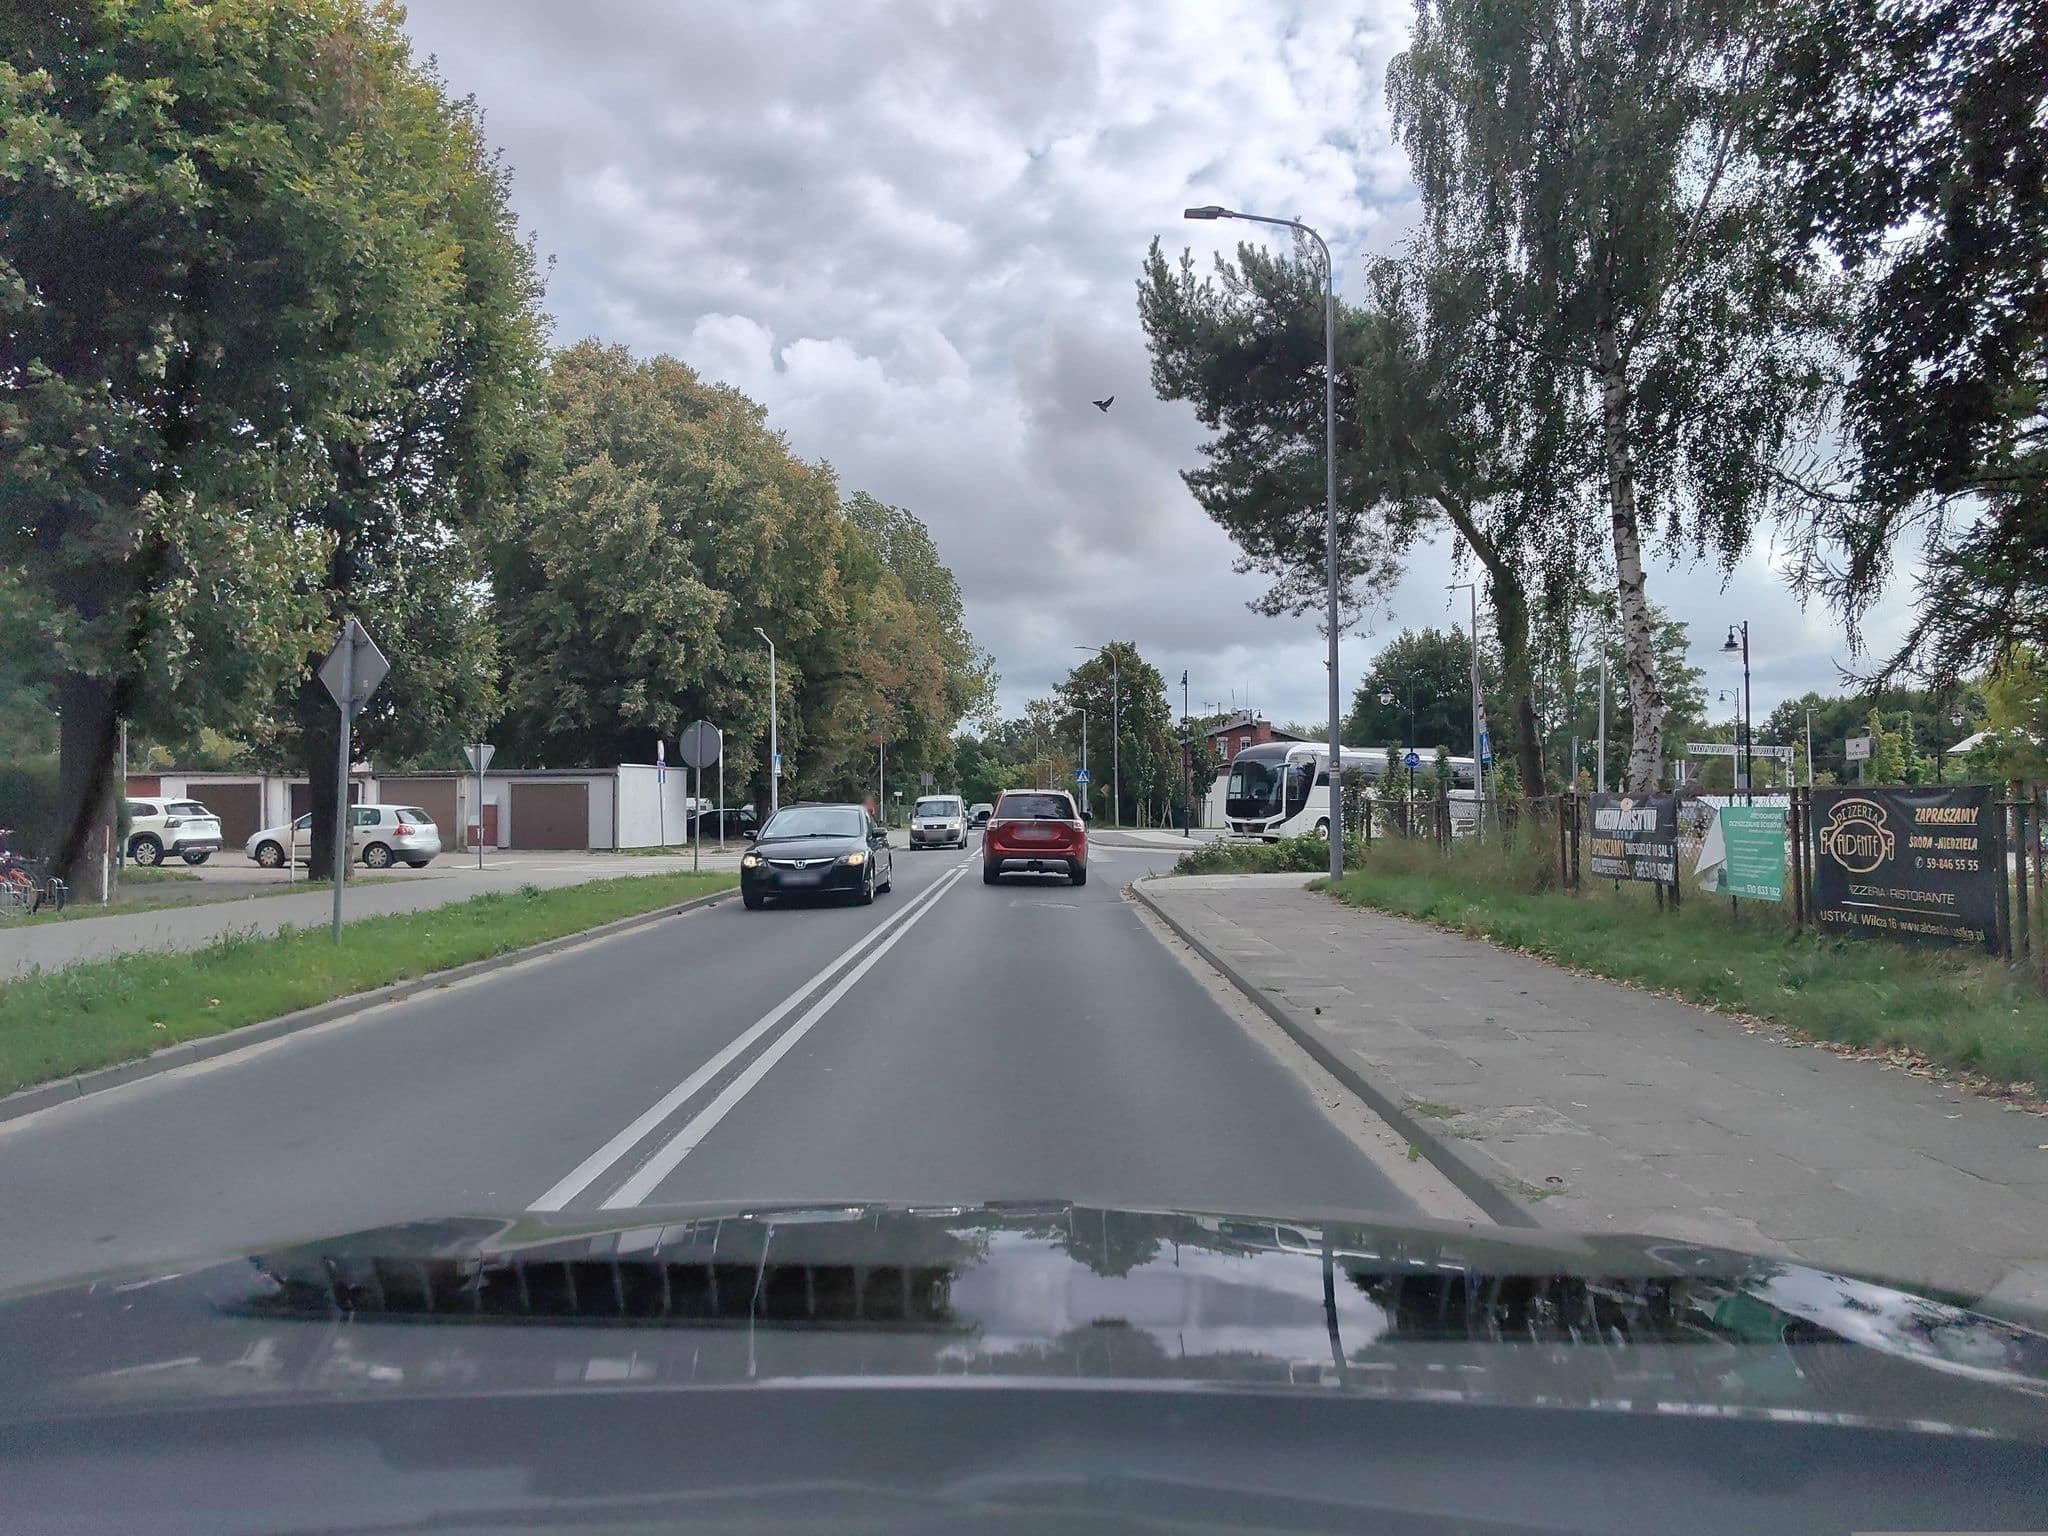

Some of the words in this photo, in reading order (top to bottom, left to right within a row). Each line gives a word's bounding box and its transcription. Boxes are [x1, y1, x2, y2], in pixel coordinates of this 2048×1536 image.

[1836, 805, 1879, 825] PIZZERIA
[1915, 807, 1979, 823] ZAPRASZAMY
[1908, 832, 1932, 848] ŚRODA
[1926, 858, 1954, 870] 59-846
[1955, 859, 1966, 870] 55
[1967, 860, 1979, 871] 55
[1890, 889, 1955, 905] RISTORANTE
